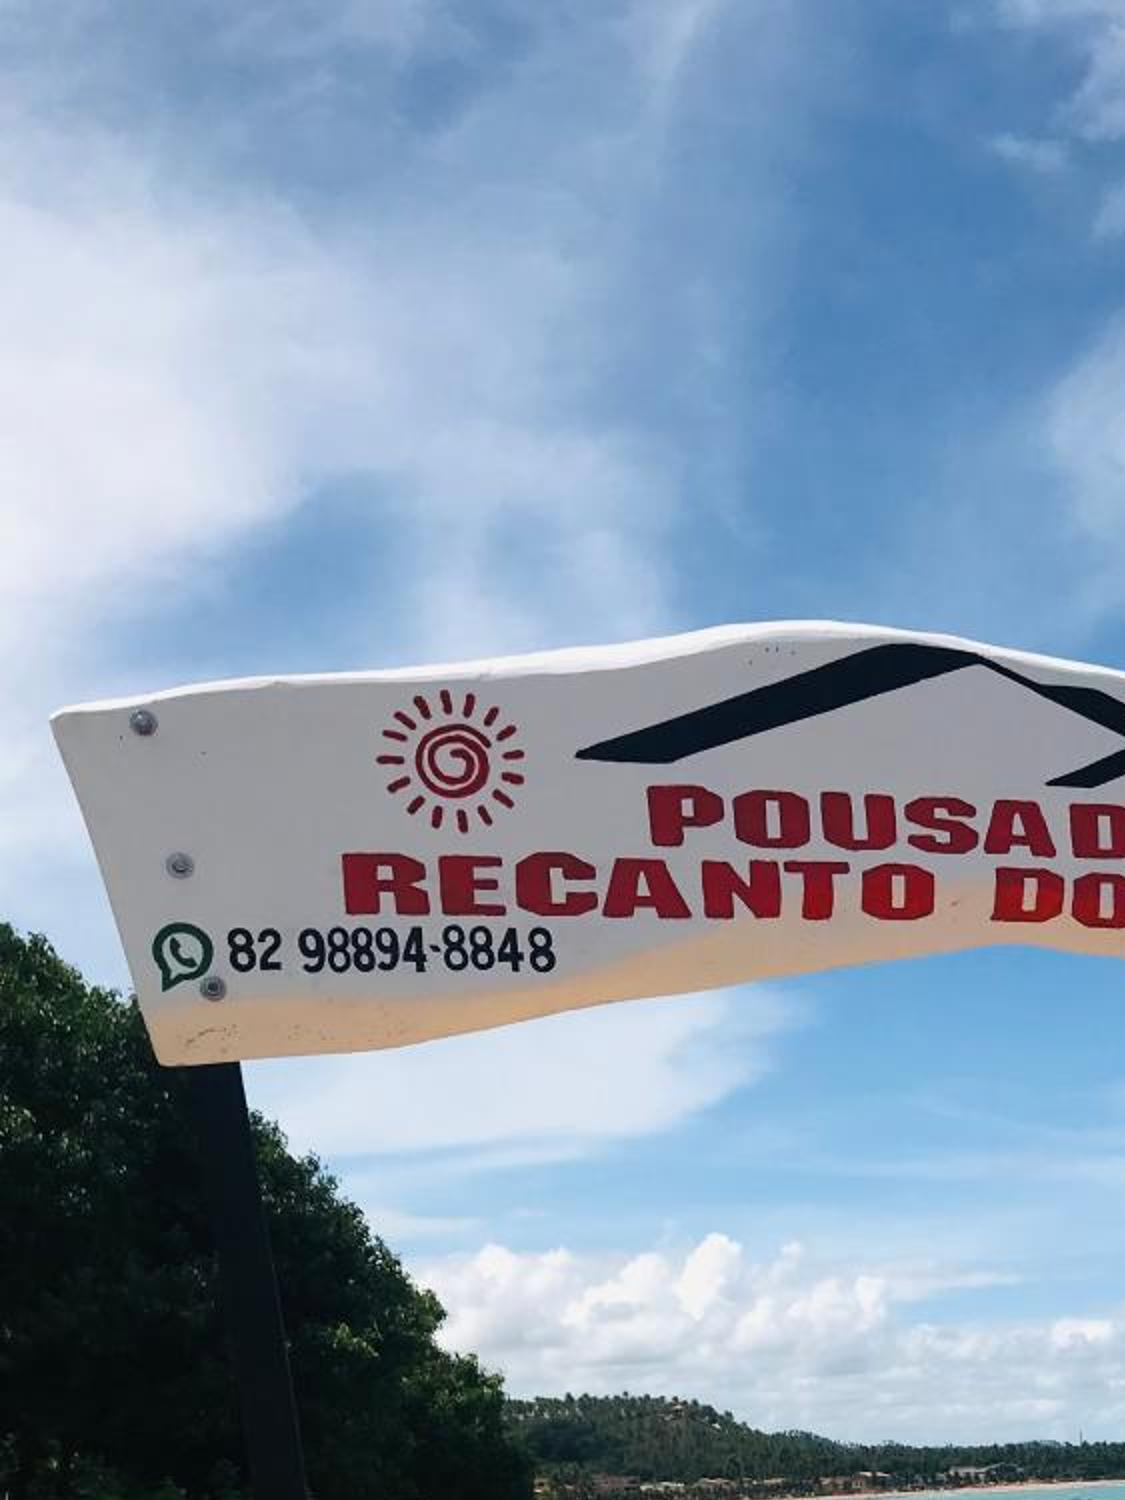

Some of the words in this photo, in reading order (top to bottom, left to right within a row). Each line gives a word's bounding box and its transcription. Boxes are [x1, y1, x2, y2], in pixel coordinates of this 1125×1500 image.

[342, 852, 935, 922] RECANTO
[227, 928, 283, 974] 82
[297, 925, 558, 975] 98894-8848
